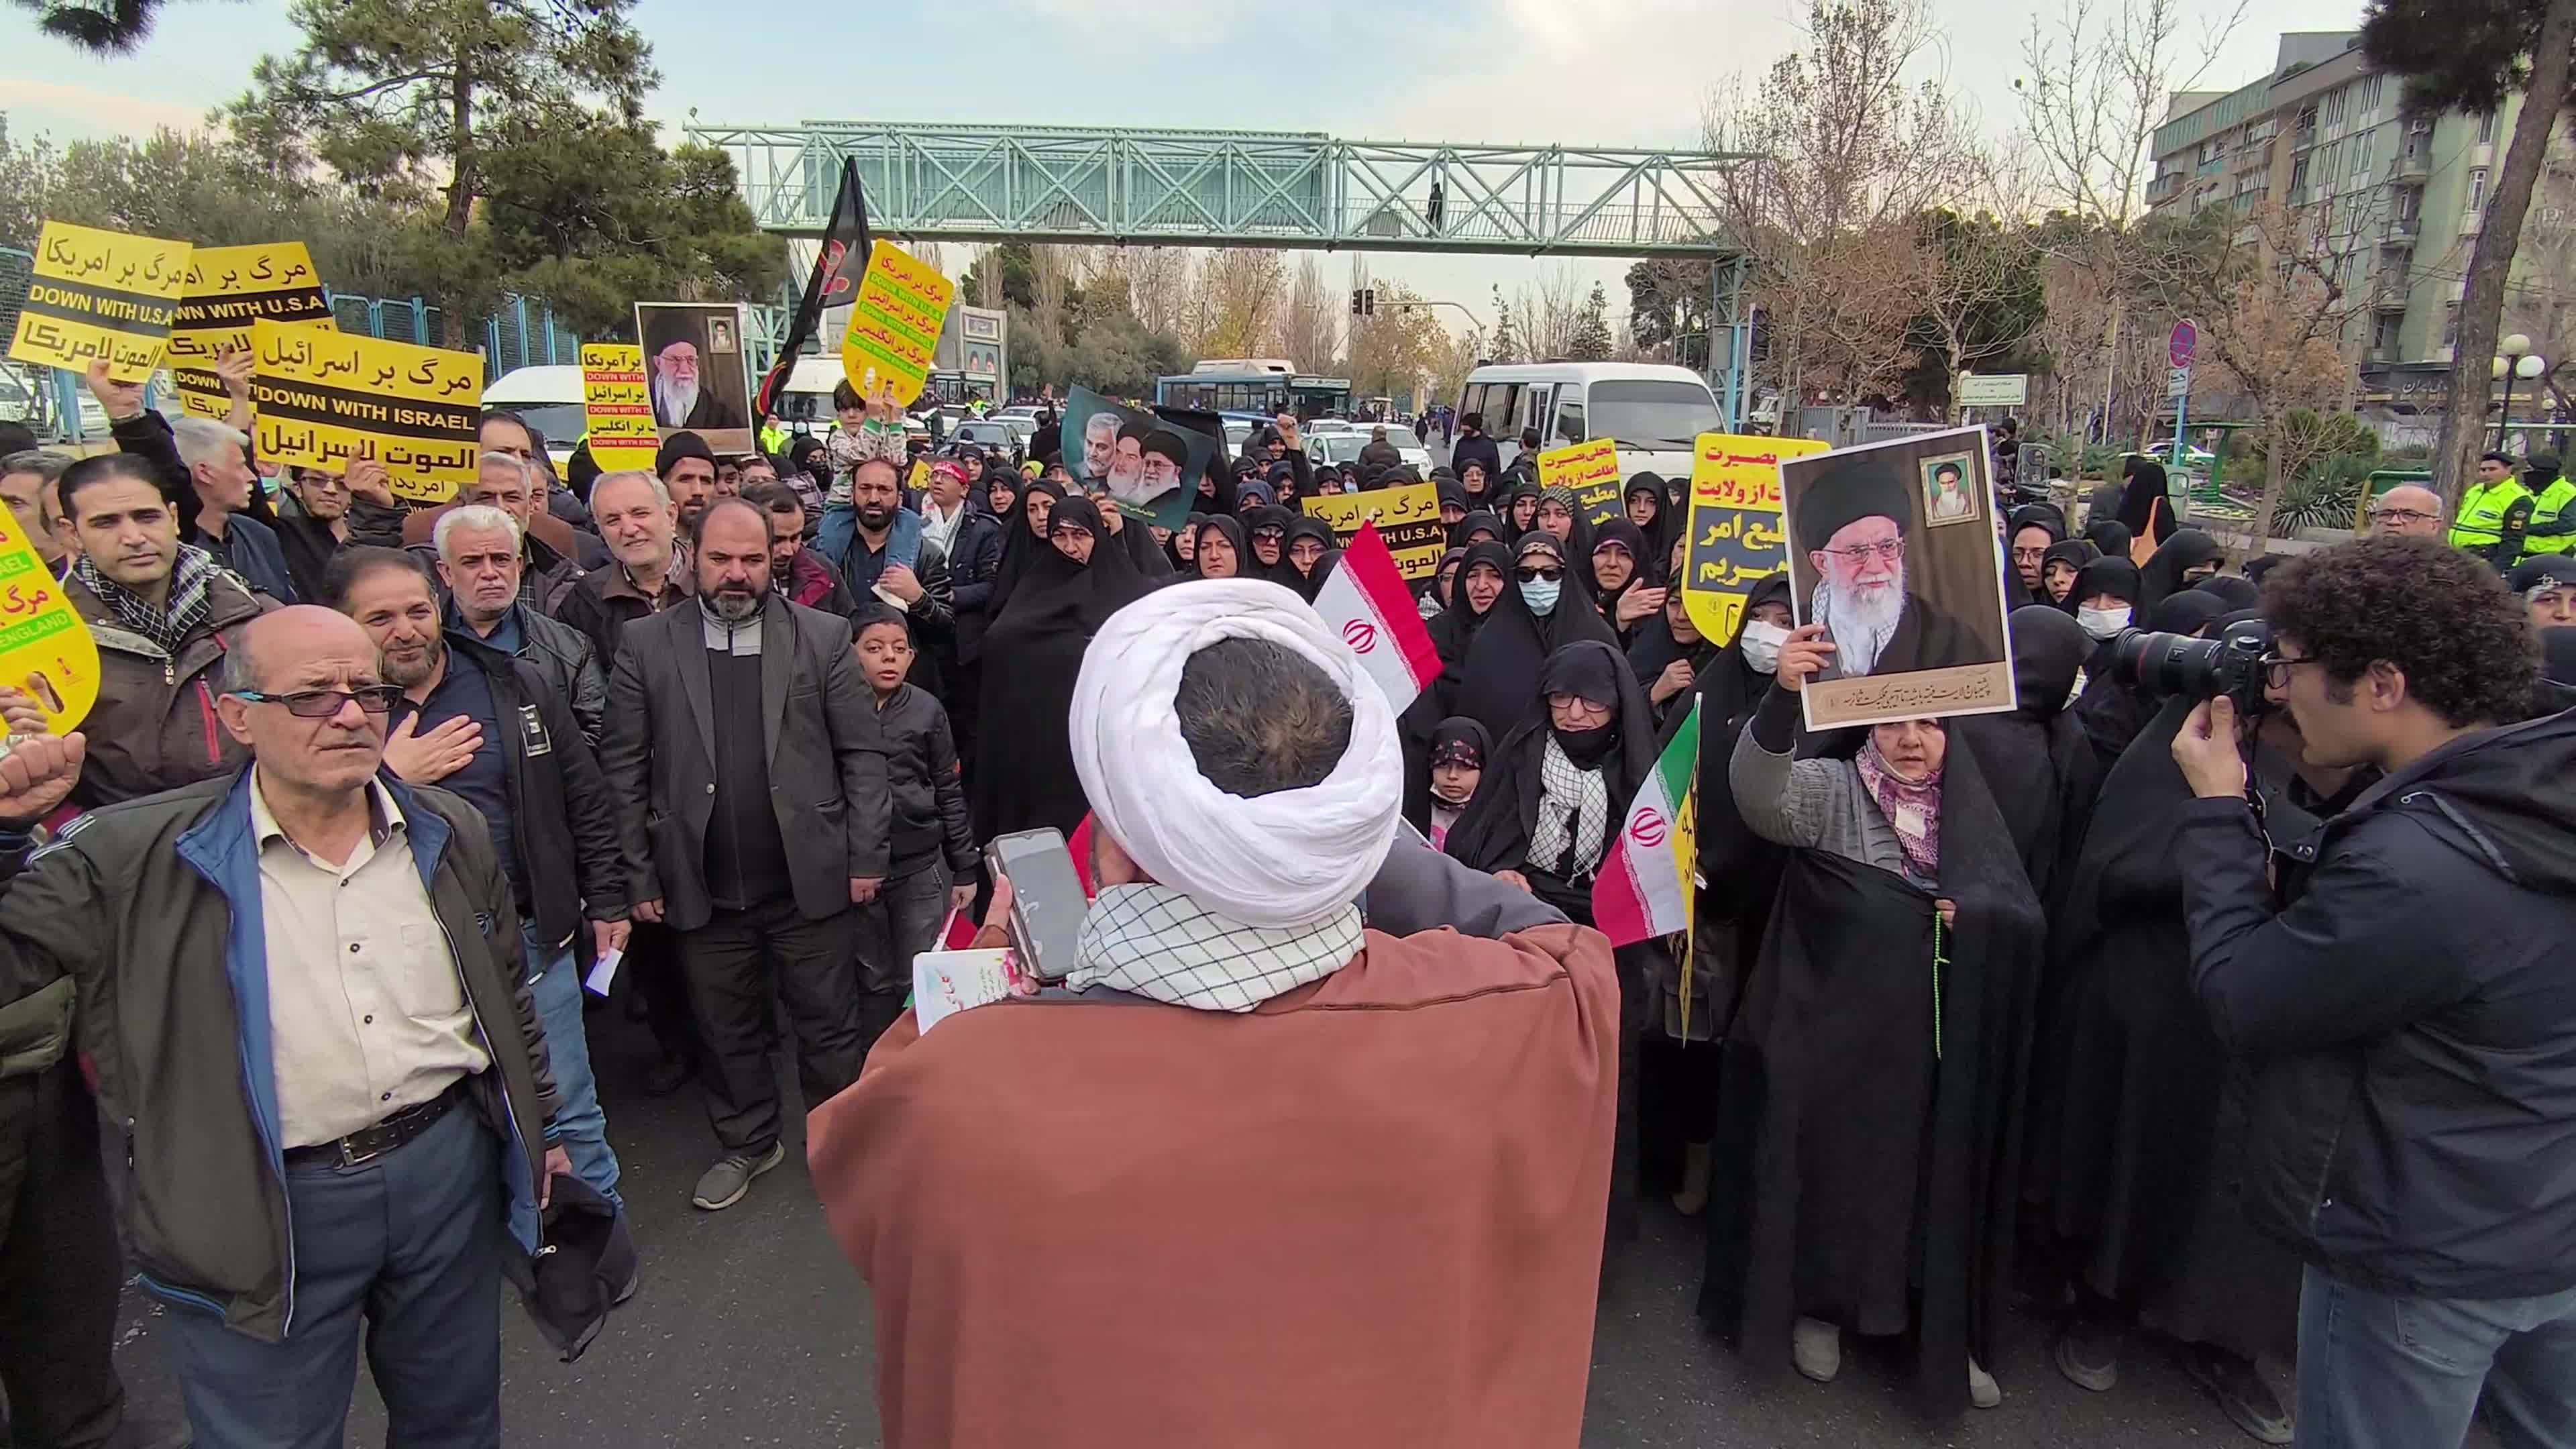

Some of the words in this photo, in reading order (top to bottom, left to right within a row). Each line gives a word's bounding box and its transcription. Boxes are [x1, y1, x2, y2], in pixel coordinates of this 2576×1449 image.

[46, 237, 111, 276] امریکا
[249, 254, 307, 284] مرگ
[115, 262, 136, 286] بر
[144, 252, 182, 290] مرگ
[219, 270, 241, 289] بر
[30, 284, 92, 312] DOWN
[96, 297, 136, 322] WITH
[140, 309, 174, 326] U.S.A
[174, 307, 205, 321] WN
[209, 301, 264, 320] WITH
[267, 295, 325, 314] U.S.A
[23, 321, 112, 362] لامریکا
[113, 344, 162, 373] الموت
[262, 337, 359, 378] اسرائیل
[584, 351, 628, 371] آمریکا
[176, 371, 221, 390] DOWN
[369, 364, 396, 390] بر
[408, 359, 472, 397] مرگ
[586, 372, 618, 381] DOWN
[619, 372, 645, 381] WITH
[588, 385, 631, 402] اسرائیل
[258, 386, 327, 412] DOWN
[333, 398, 387, 422] WITH
[394, 407, 476, 431] ISRAEL
[590, 406, 618, 414] DOWN
[619, 406, 641, 414] WITH
[590, 419, 631, 435] انگلیس
[386, 447, 475, 474] الموت
[1705, 446, 1778, 469] بصیرت
[1580, 486, 1617, 511] مطیع
[1697, 481, 1746, 504] ولایت
[1748, 483, 1766, 504] از
[1393, 494, 1434, 518] مرگ
[1400, 525, 1442, 542] U.S.A
[1699, 513, 1741, 547] امر
[3, 584, 48, 614] مرگ
